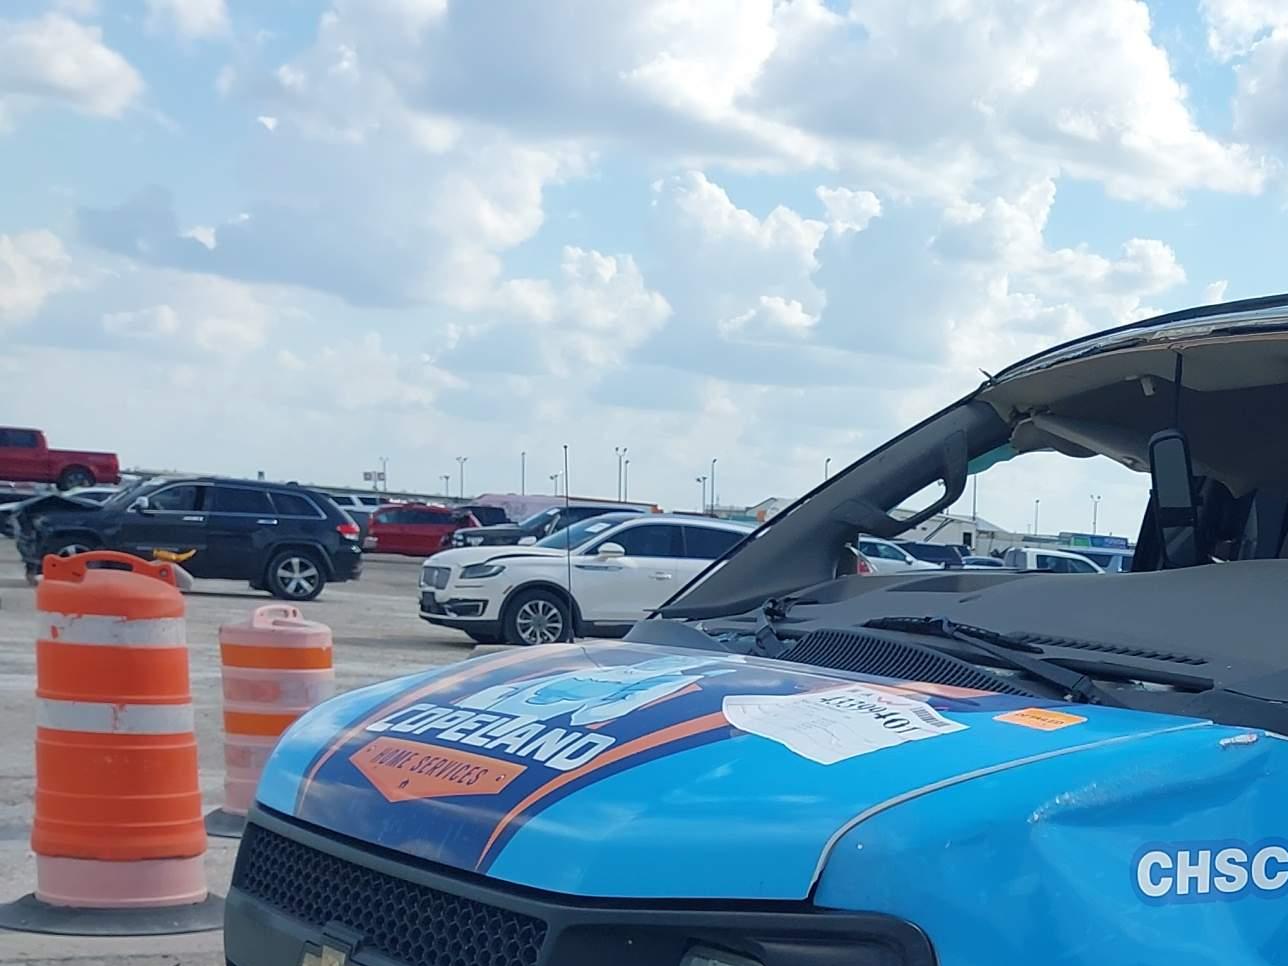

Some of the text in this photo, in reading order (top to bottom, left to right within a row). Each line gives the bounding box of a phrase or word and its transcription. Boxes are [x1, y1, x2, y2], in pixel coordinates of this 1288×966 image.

[366, 703, 616, 771] COPELAND
[370, 745, 489, 786] HOME SERVICES
